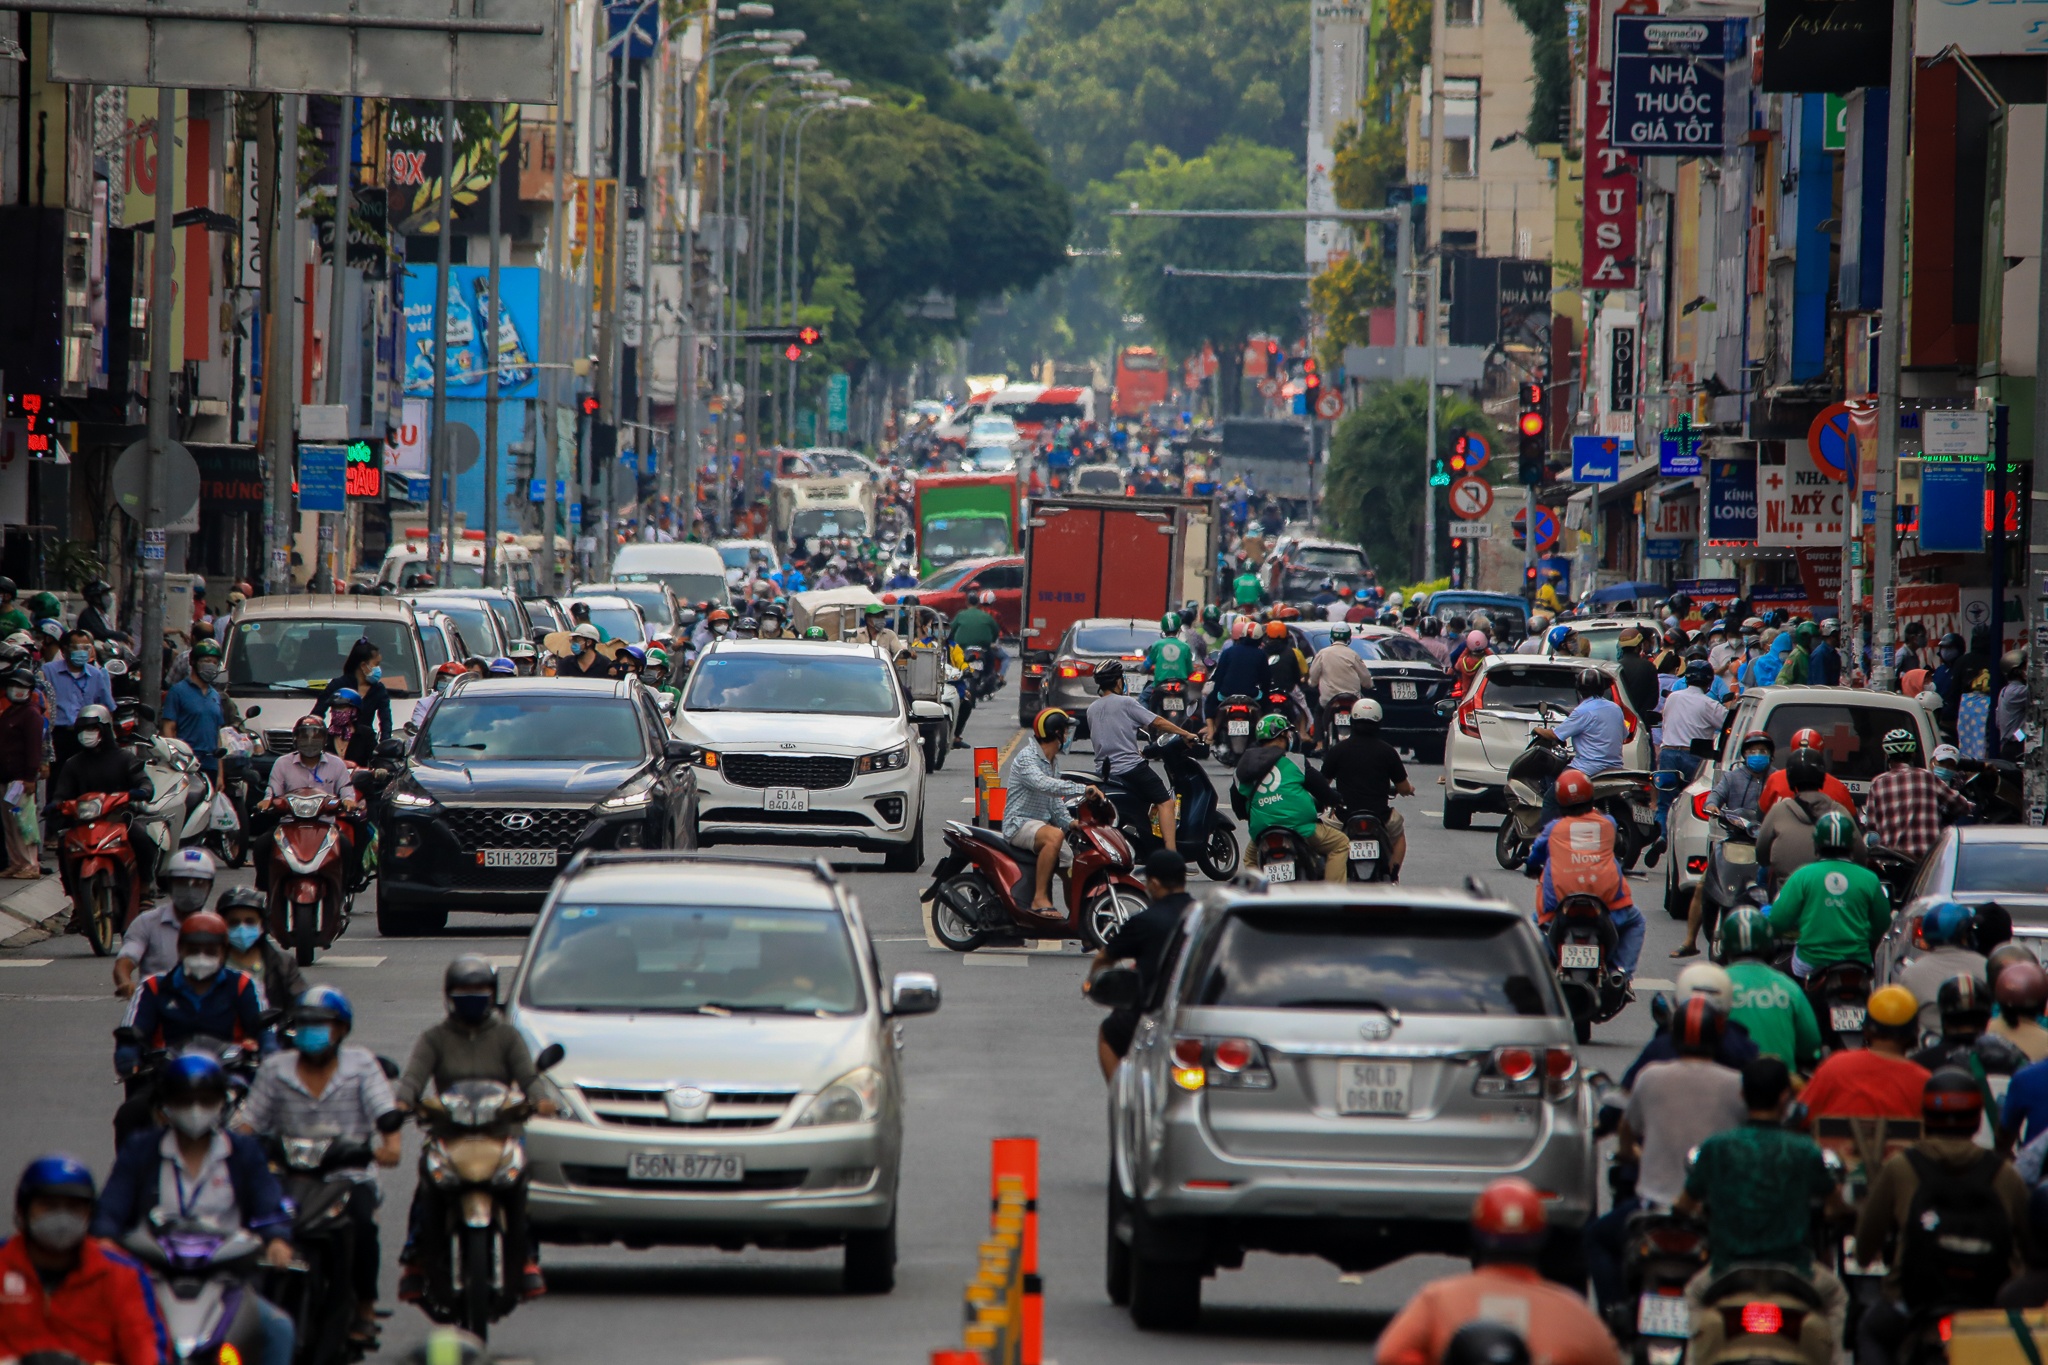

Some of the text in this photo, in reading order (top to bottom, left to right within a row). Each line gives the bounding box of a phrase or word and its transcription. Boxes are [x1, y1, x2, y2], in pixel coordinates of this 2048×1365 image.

[1648, 27, 1704, 43] Pharmacity
[1778, 5, 1864, 50] fashion
[1635, 85, 1711, 114] THUỐC
[1631, 115, 1714, 142] GIÁ TỐT
[1615, 329, 1633, 410] DOLLY
[347, 441, 371, 462] UỐC
[1724, 487, 1753, 501] KÍNH
[1791, 490, 1826, 516] MỸ
[1714, 506, 1758, 520] LONG
[1818, 577, 1842, 590] DỤN
[776, 789, 797, 800] 61A
[1258, 793, 1284, 807] gojek
[769, 800, 804, 811] 840.48
[487, 851, 555, 866] 51H-328.75
[1571, 853, 1601, 865] Now
[1269, 872, 1293, 882] 84.57
[1730, 981, 1792, 1010] Grab
[634, 1155, 738, 1178] 56N-8779
